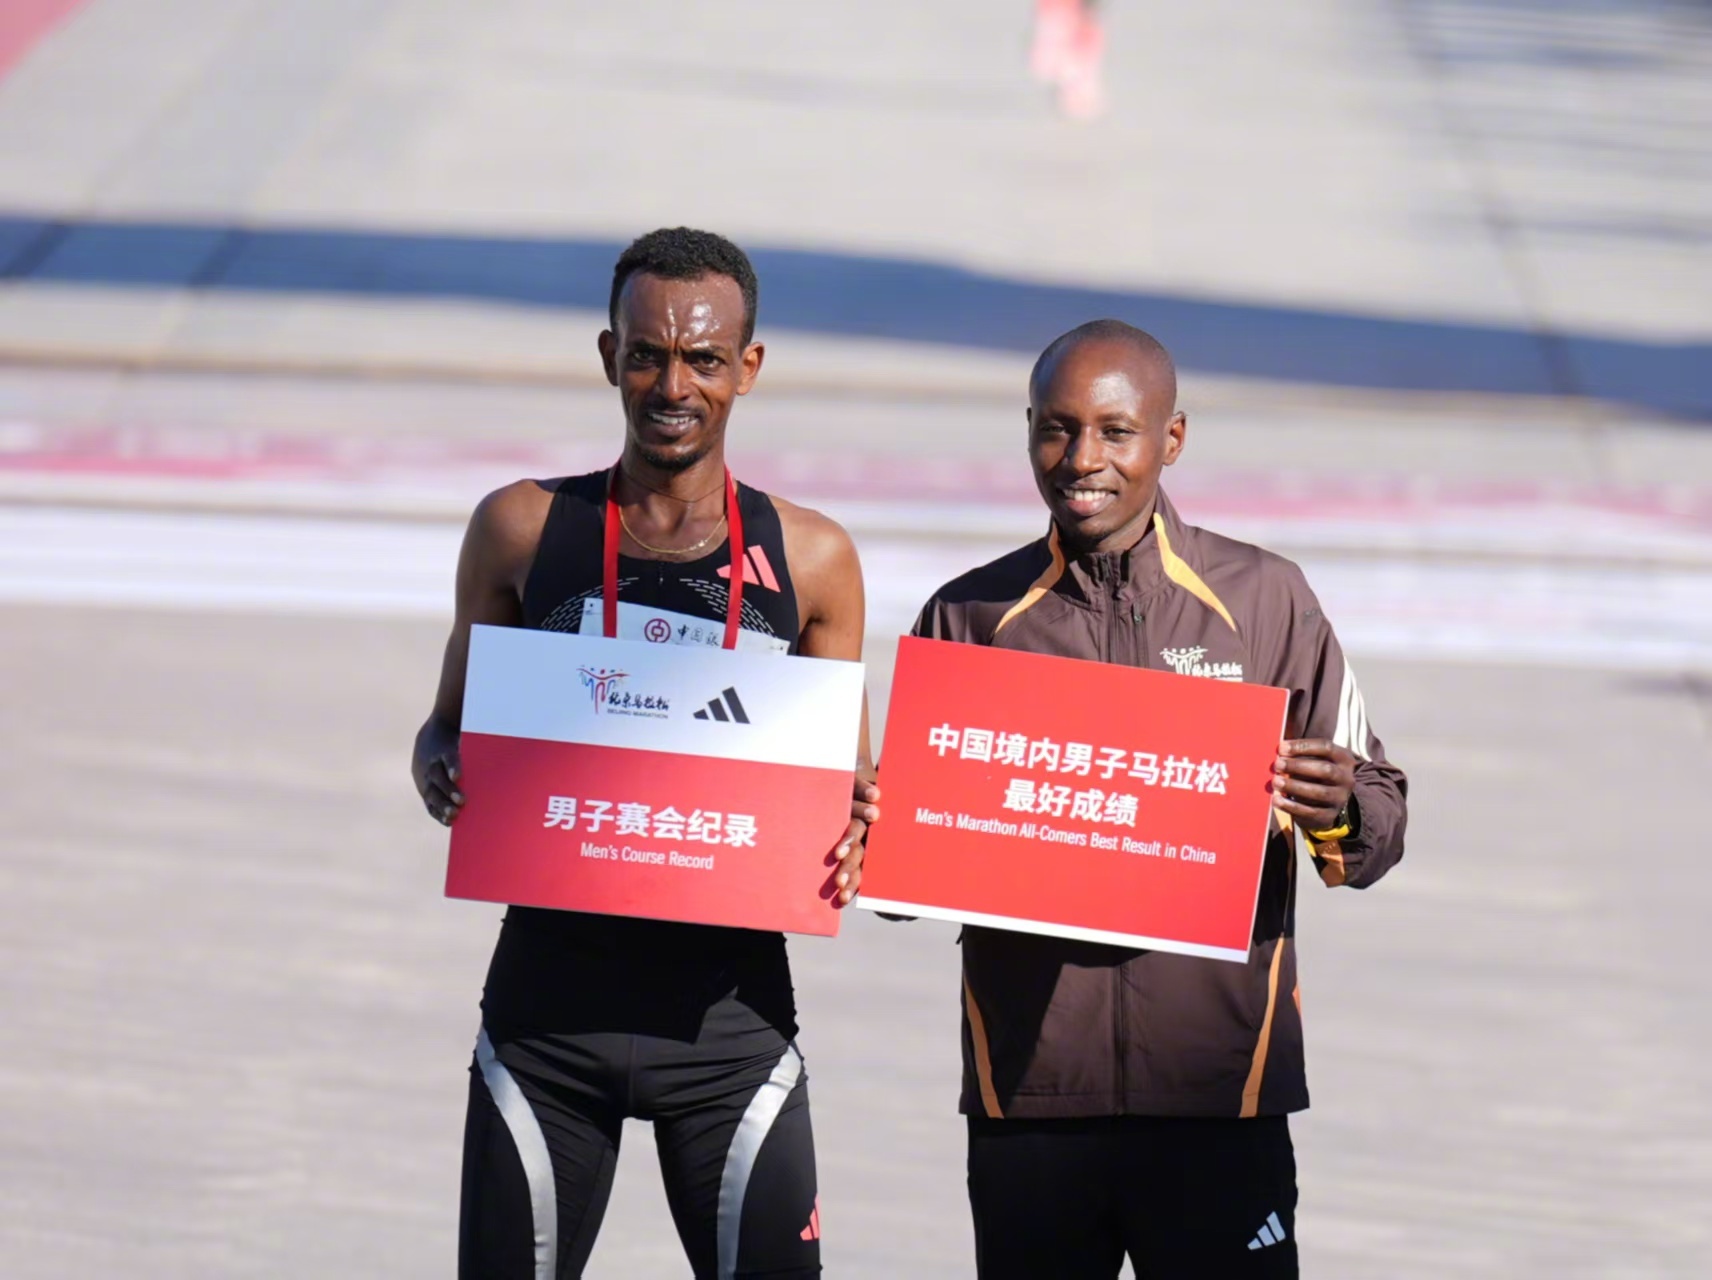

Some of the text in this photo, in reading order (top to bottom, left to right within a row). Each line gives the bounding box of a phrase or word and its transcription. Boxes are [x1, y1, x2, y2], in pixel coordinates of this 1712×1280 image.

[928, 723, 1229, 795] 中国境内男子马拉松
[543, 795, 758, 848] 男子赛会纪录
[1003, 779, 1138, 827] 最好成绩
[580, 842, 714, 870] Men's Course Record
[915, 807, 1216, 865] Men's Marathon All-Comers Best Result in China
